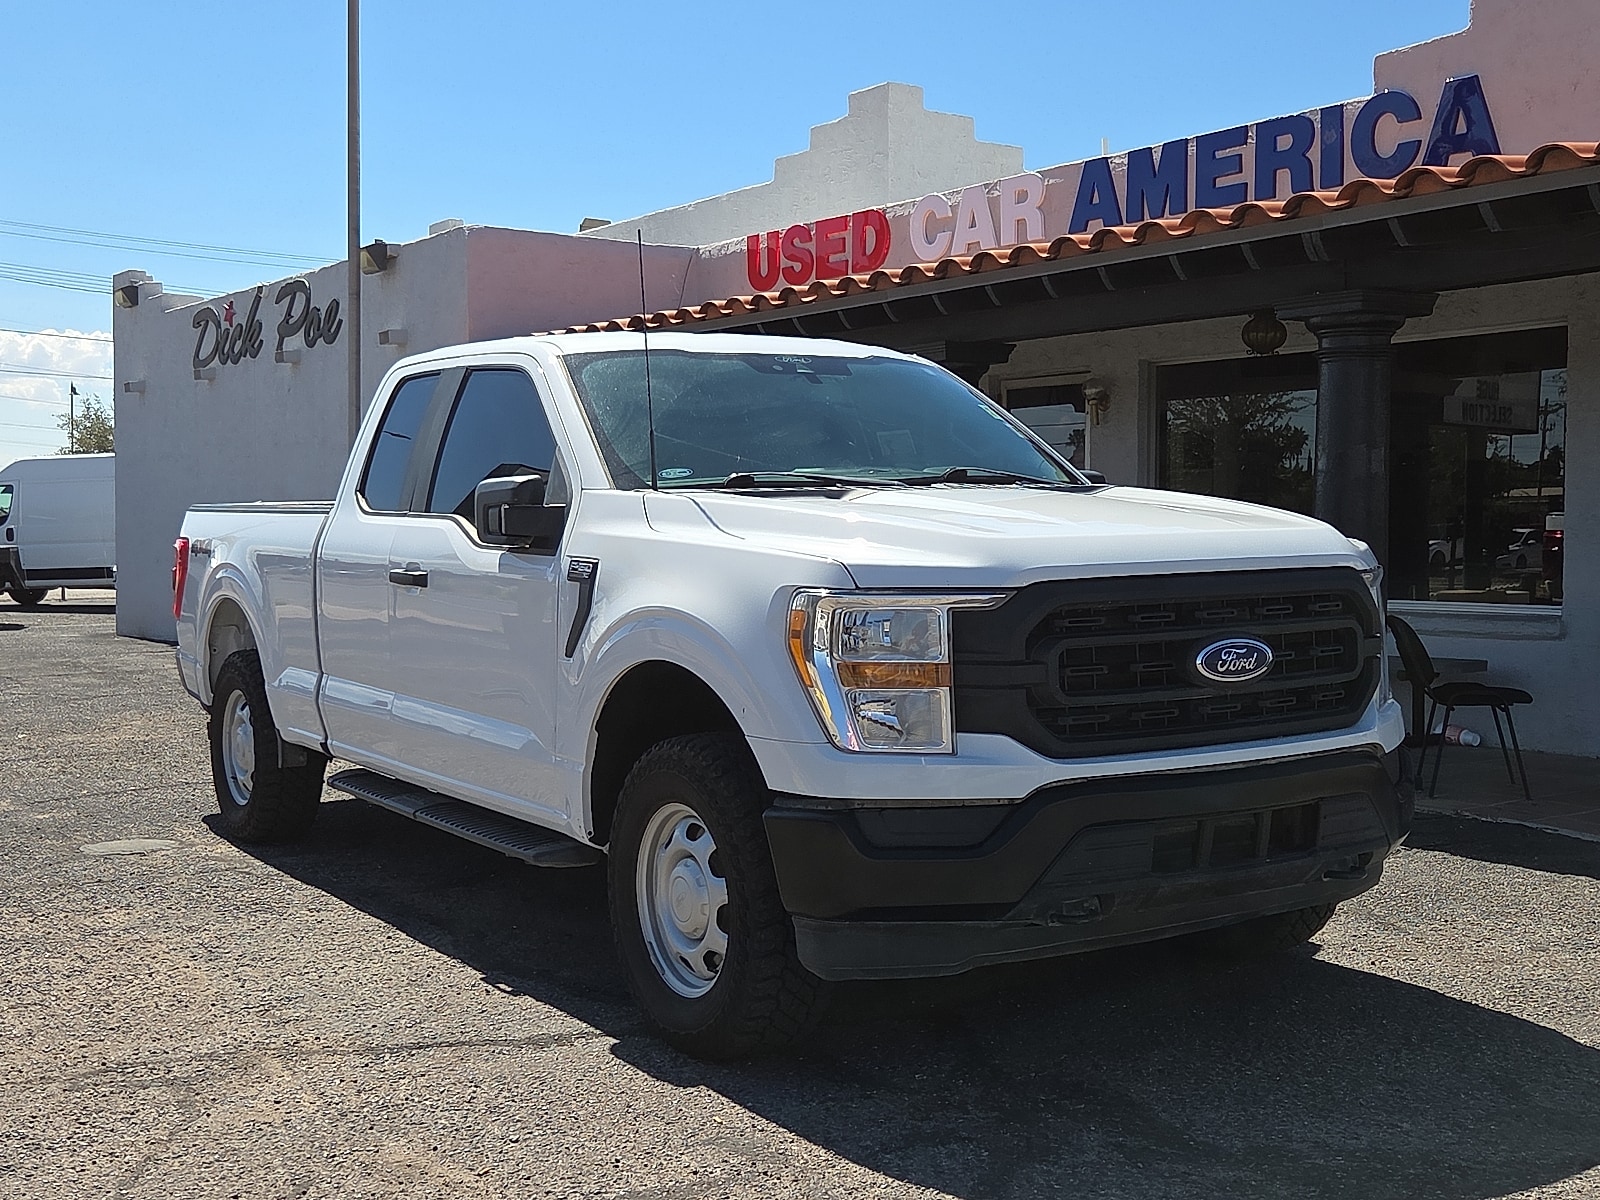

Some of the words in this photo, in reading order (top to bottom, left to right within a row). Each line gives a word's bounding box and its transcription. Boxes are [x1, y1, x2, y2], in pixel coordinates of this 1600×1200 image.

[747, 209, 890, 293] USED
[909, 172, 1045, 262] CAR
[1068, 75, 1502, 235] AMERICA
[192, 285, 264, 369] Dick
[275, 278, 343, 352] Poe
[1217, 648, 1258, 672] Ford
